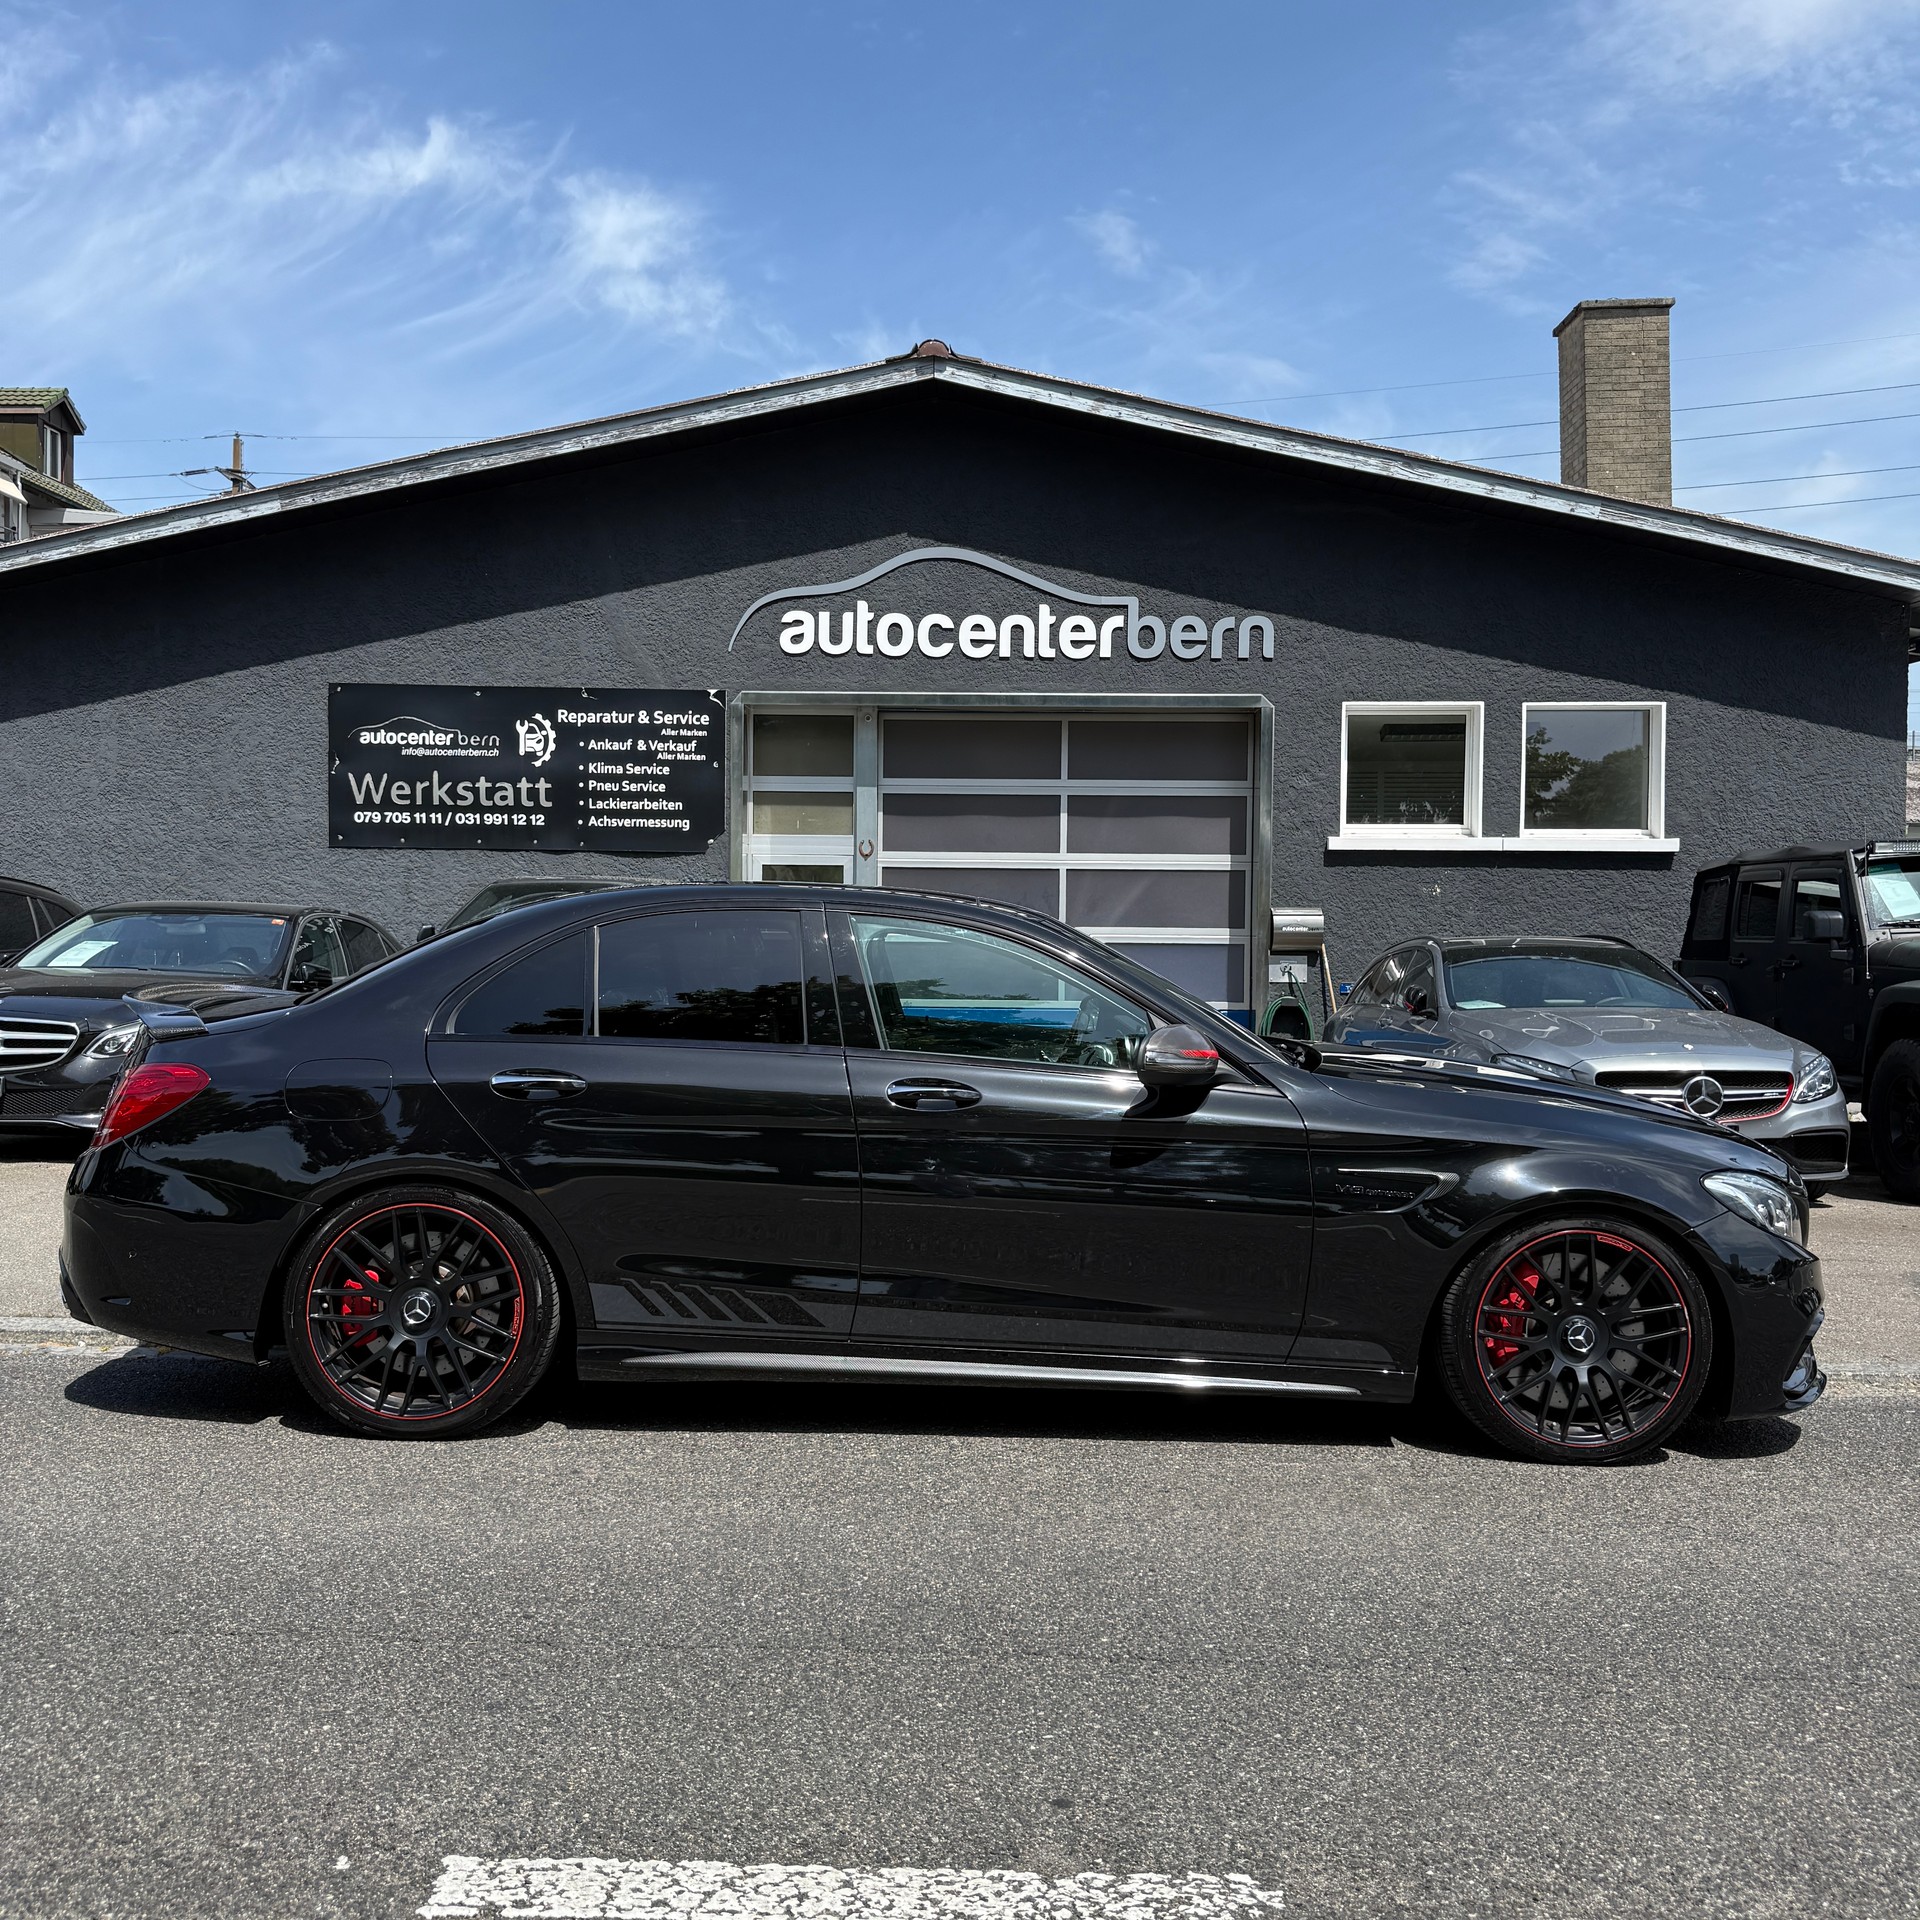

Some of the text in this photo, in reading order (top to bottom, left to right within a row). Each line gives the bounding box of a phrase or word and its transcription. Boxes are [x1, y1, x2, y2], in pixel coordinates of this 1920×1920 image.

[557, 708, 710, 728] Reparatur & Service
[660, 727, 708, 737] Aller Marken
[587, 738, 698, 752] Ankauf & Verkauf
[401, 747, 500, 758] info@autocenterbern.ch
[656, 752, 707, 761] Aller Marken
[588, 761, 671, 776] Klima Service
[347, 770, 553, 808] Werkstatt
[588, 779, 667, 793] Pneu Service
[588, 797, 684, 811] Lackierarbeiten
[353, 811, 546, 827] 079 705 11 11 / 031 991 12 12
[587, 814, 691, 832] Achsvermessung
